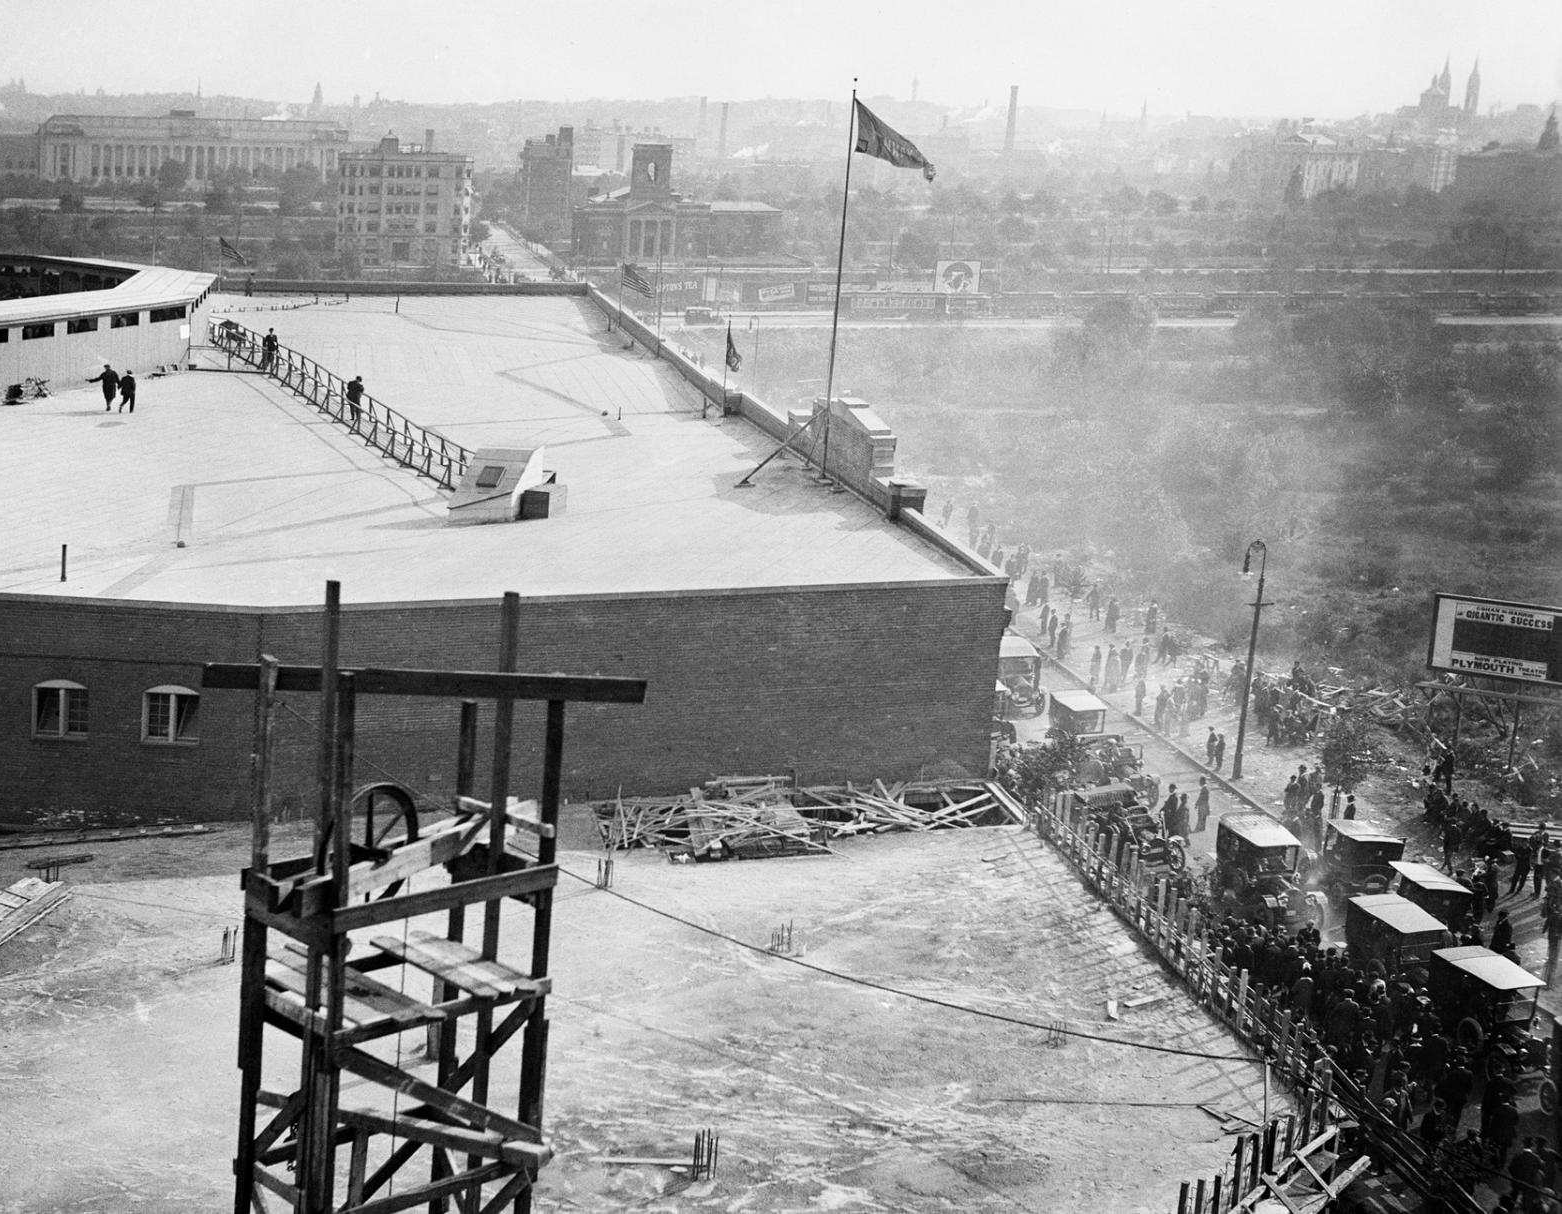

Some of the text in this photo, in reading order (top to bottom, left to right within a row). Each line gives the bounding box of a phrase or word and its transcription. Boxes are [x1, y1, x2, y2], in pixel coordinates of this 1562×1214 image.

[684, 281, 698, 289] TEA
[1466, 610, 1553, 629] GIGANTIC SUCCESS
[1452, 658, 1515, 674] PLYMOUTH
[1492, 657, 1524, 667] PLAYING
